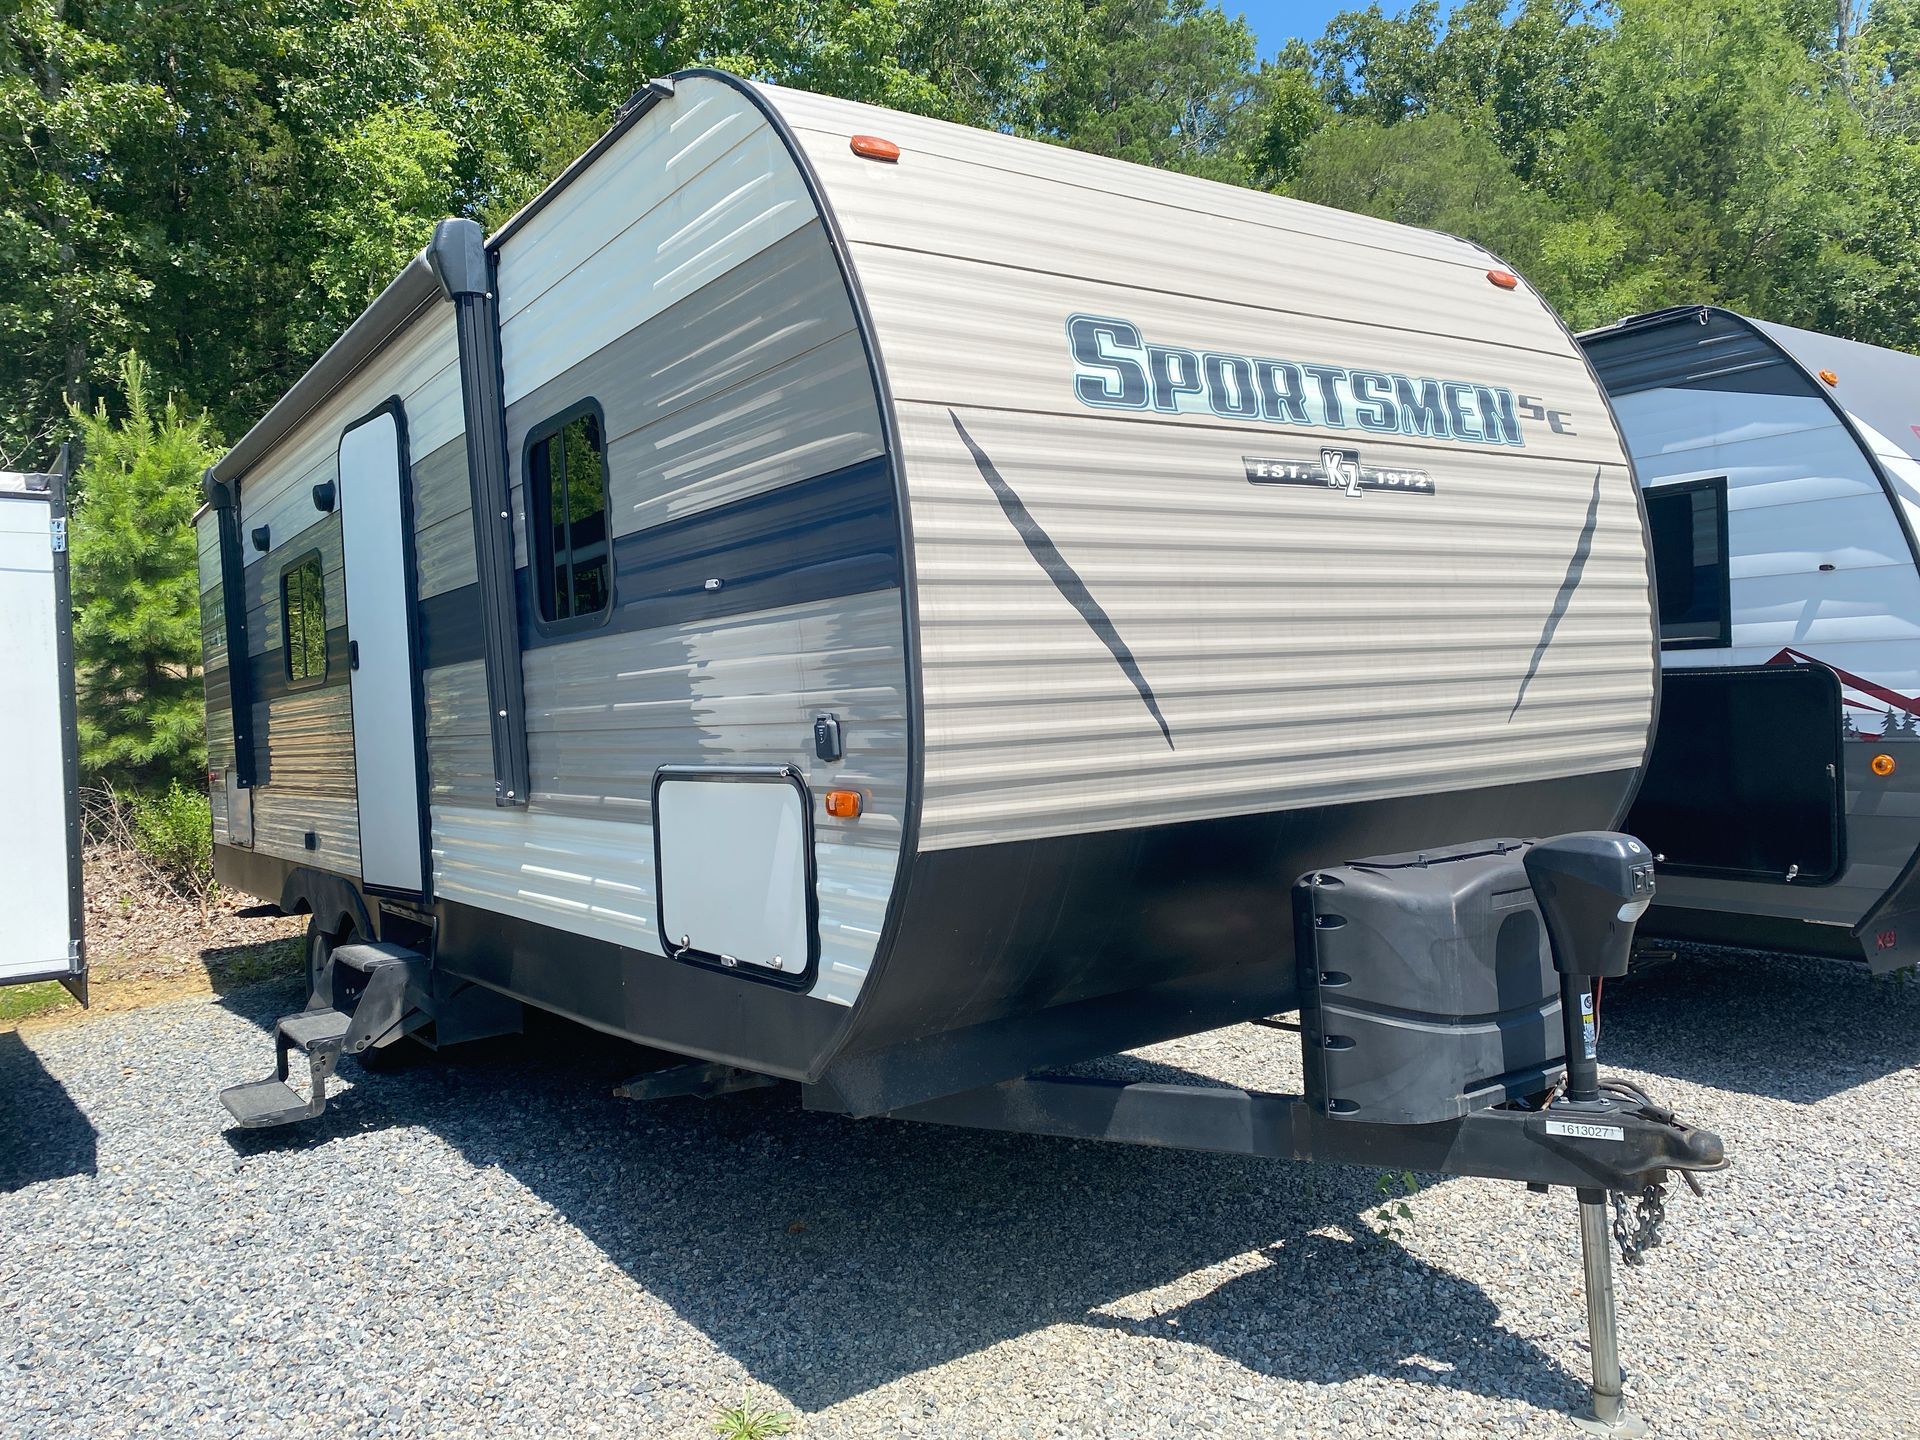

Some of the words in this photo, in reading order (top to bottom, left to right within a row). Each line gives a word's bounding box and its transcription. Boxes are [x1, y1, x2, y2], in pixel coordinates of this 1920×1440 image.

[1065, 313, 1525, 447] SPORTSMEN
[1518, 394, 1577, 436] SE
[1256, 464, 1308, 479] EST.
[1322, 451, 1363, 498] KZ
[1375, 472, 1428, 487] 1972
